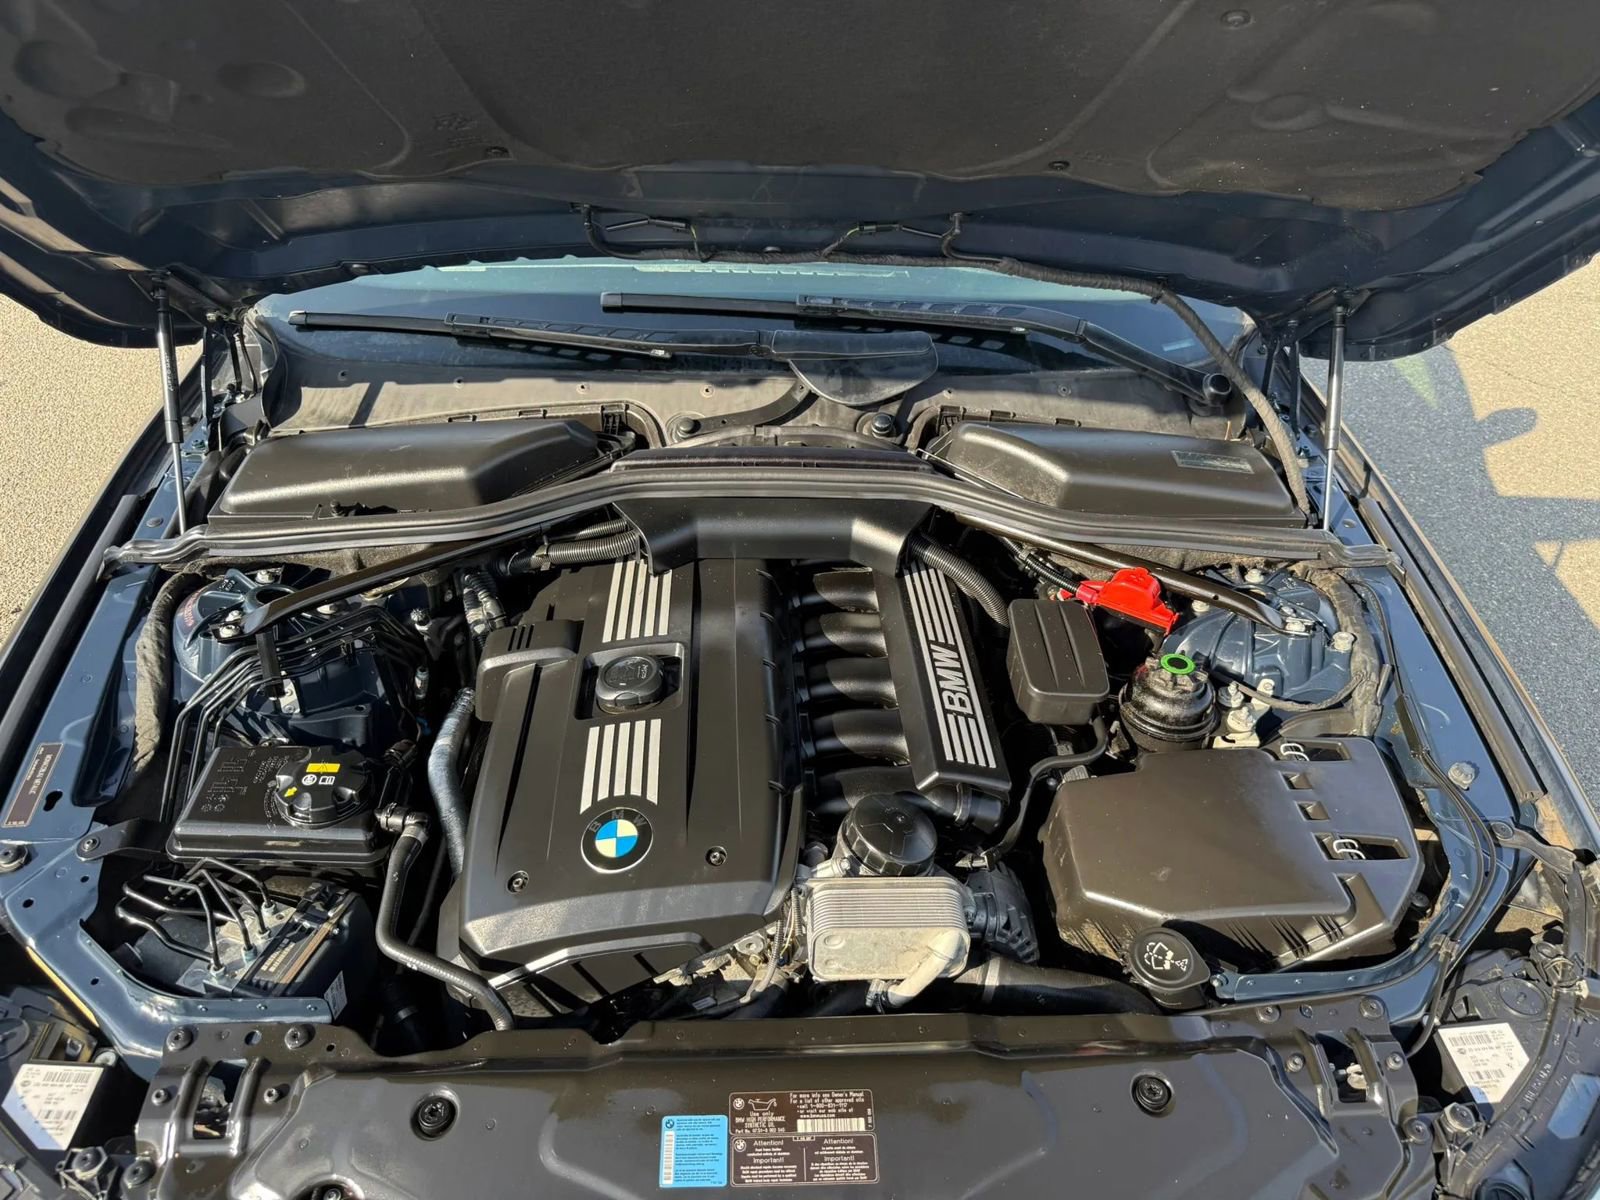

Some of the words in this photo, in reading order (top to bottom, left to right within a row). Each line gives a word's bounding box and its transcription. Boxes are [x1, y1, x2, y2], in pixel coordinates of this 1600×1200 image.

[930, 643, 974, 715] BMW
[589, 810, 647, 832] BMW
[753, 1139, 784, 1147] Attention!
[823, 1137, 854, 1145] Attention!
[753, 1156, 785, 1164] Important!
[824, 1154, 855, 1163] Important!
